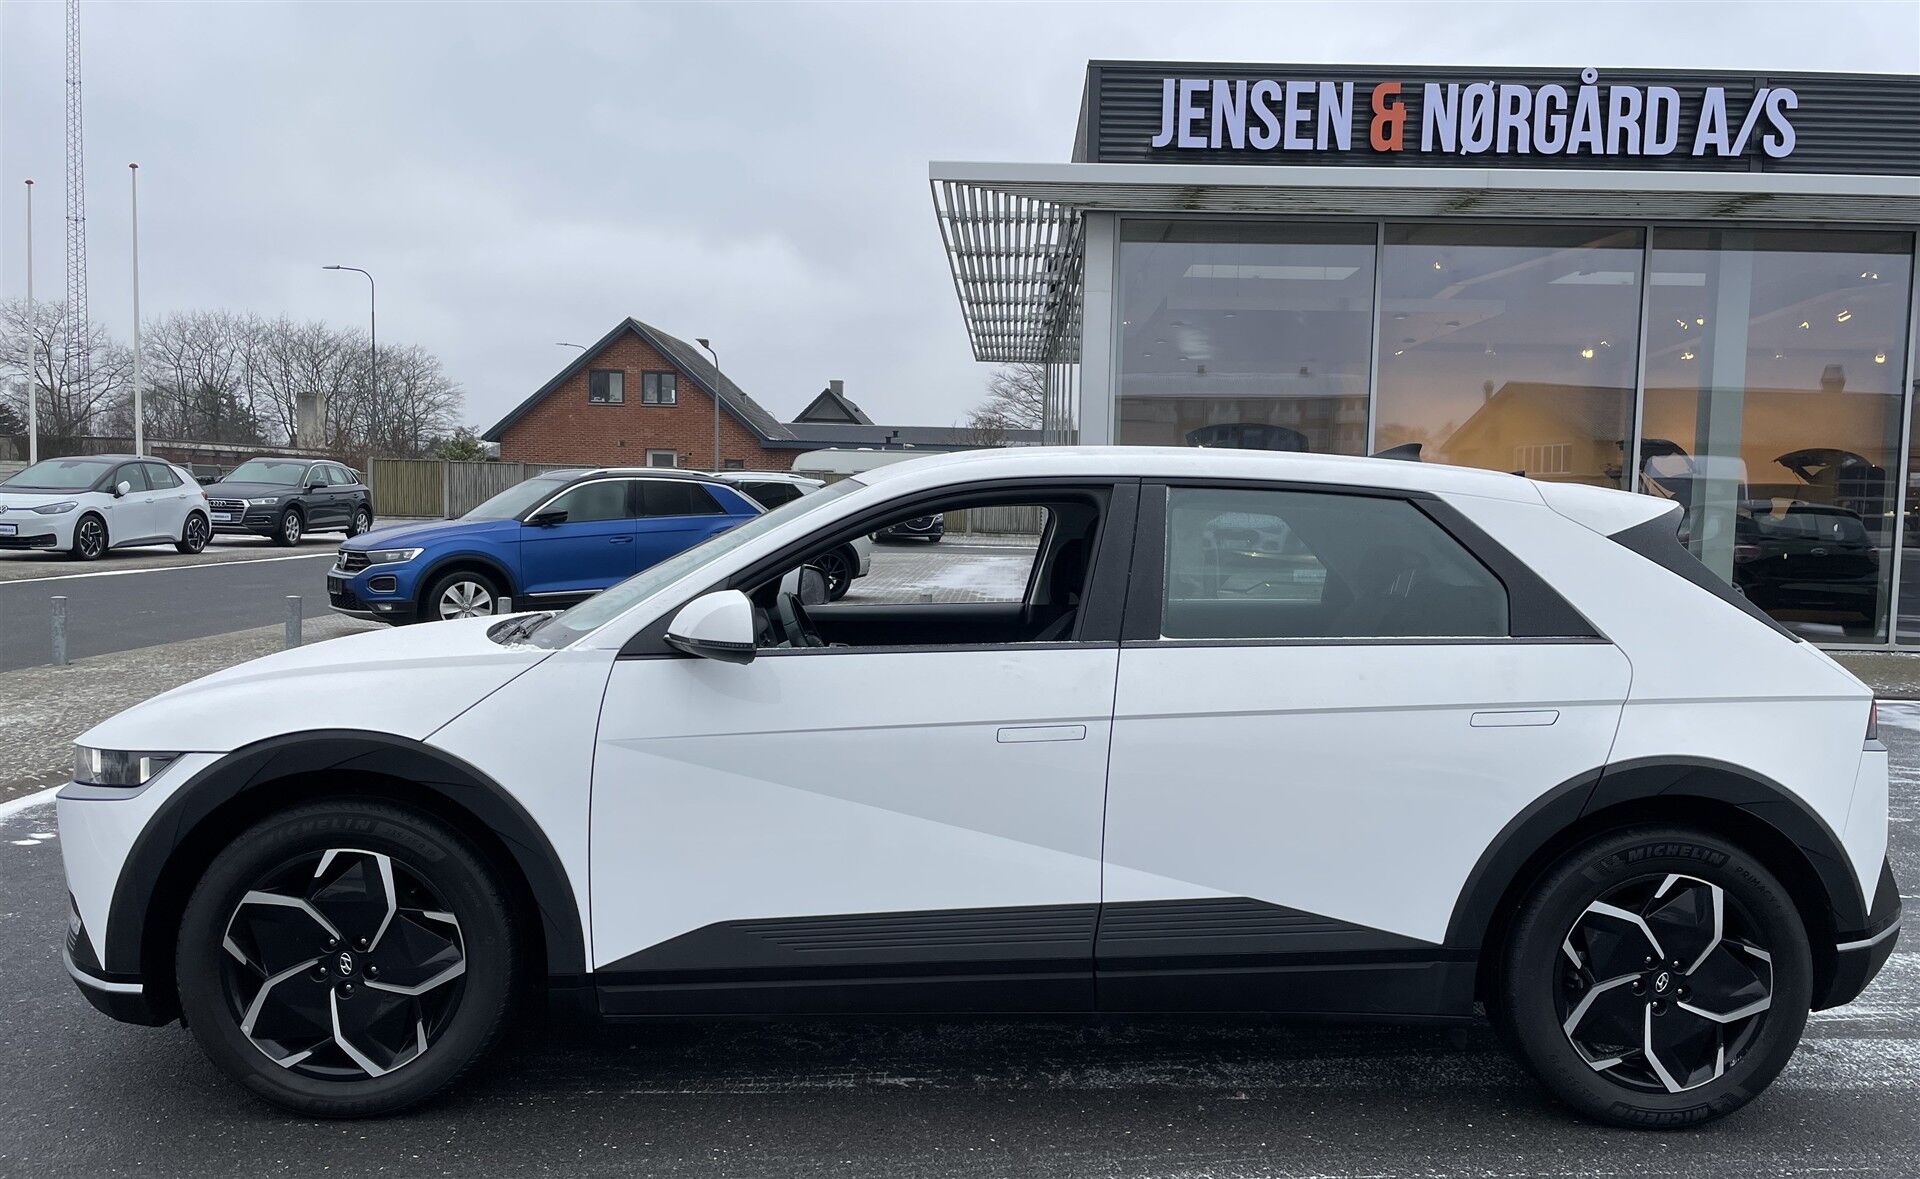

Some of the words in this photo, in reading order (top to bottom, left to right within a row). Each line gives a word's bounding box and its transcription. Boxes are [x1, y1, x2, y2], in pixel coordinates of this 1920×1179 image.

[1152, 78, 1354, 151] JENSEN
[1369, 82, 1407, 152] &
[1420, 67, 1681, 156] NØRGÅRD
[1691, 87, 1799, 158] A/S
[1627, 844, 1726, 866] MICHELIN
